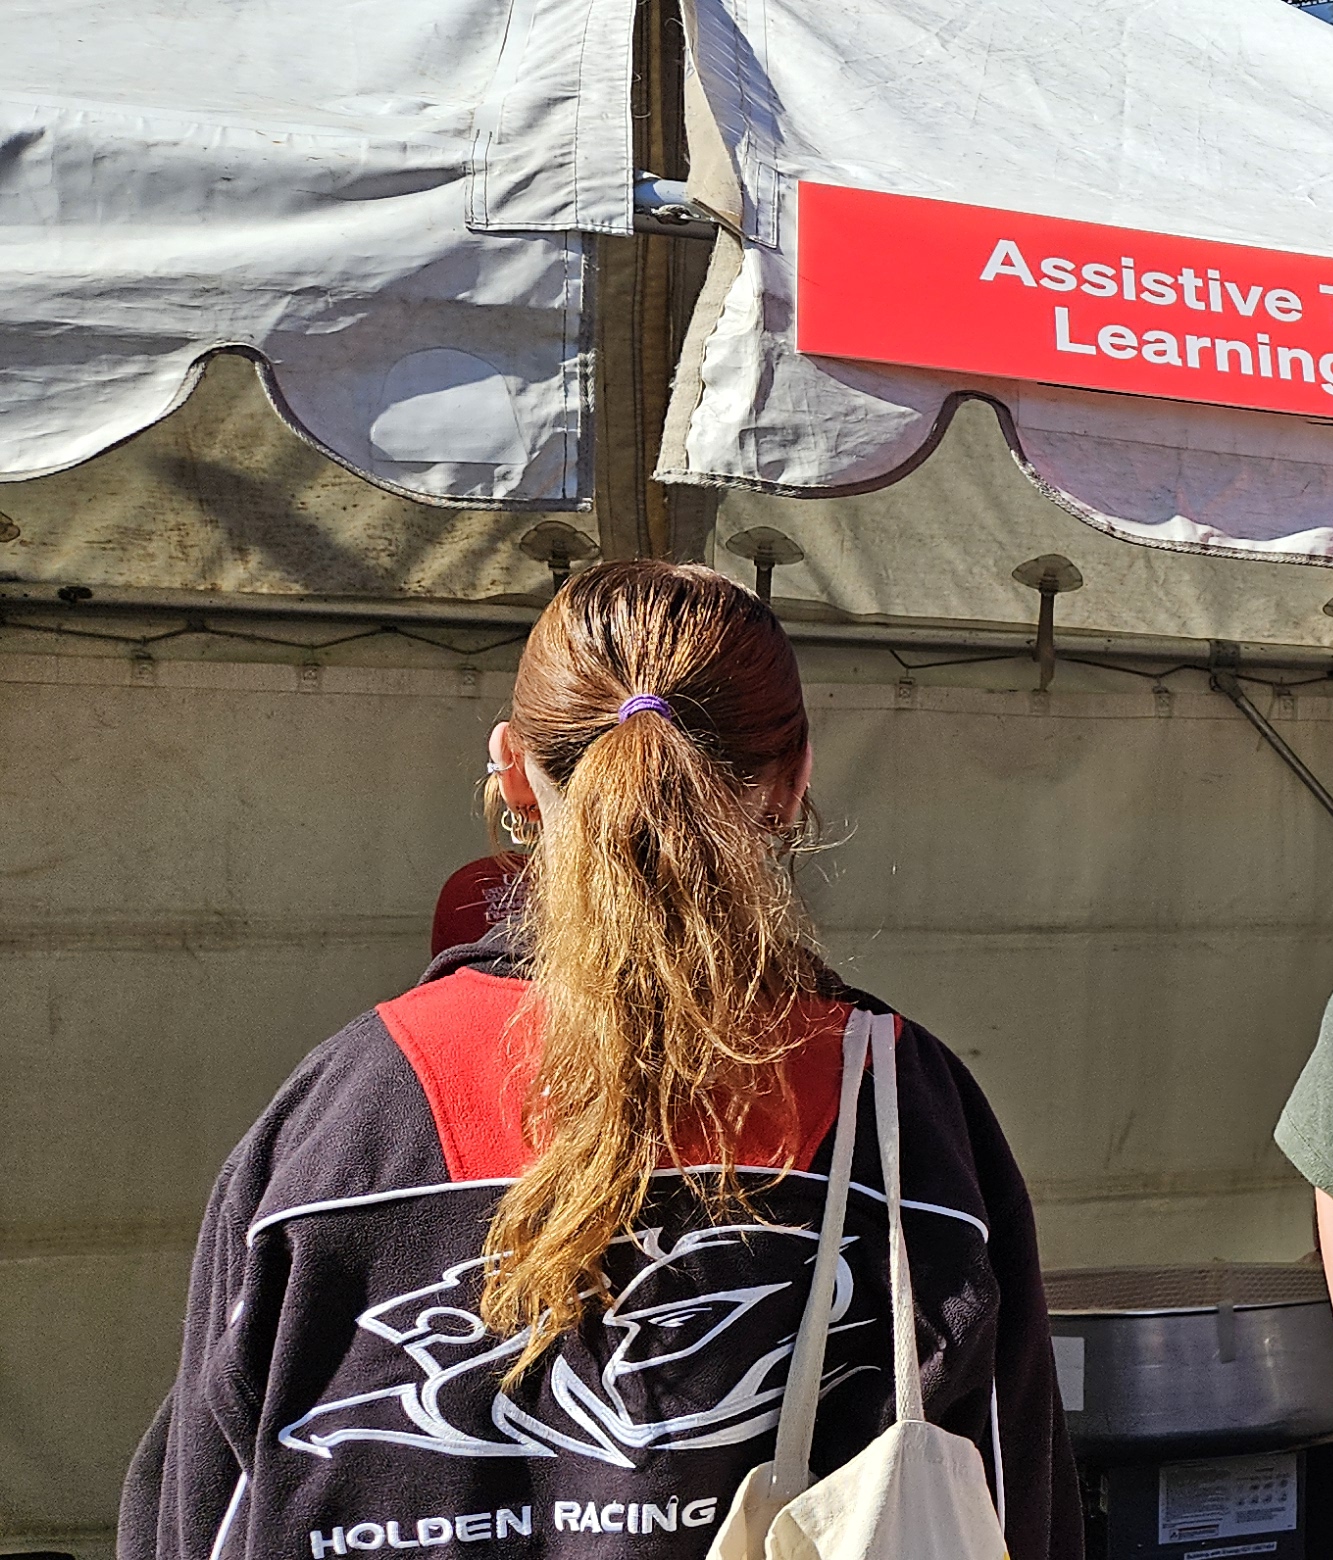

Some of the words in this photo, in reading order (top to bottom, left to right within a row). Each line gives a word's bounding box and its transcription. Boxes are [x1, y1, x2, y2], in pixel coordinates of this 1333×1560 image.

[980, 240, 1302, 323] Assistive
[309, 1505, 532, 1560] HOLDEN
[553, 1494, 718, 1535] RACING
